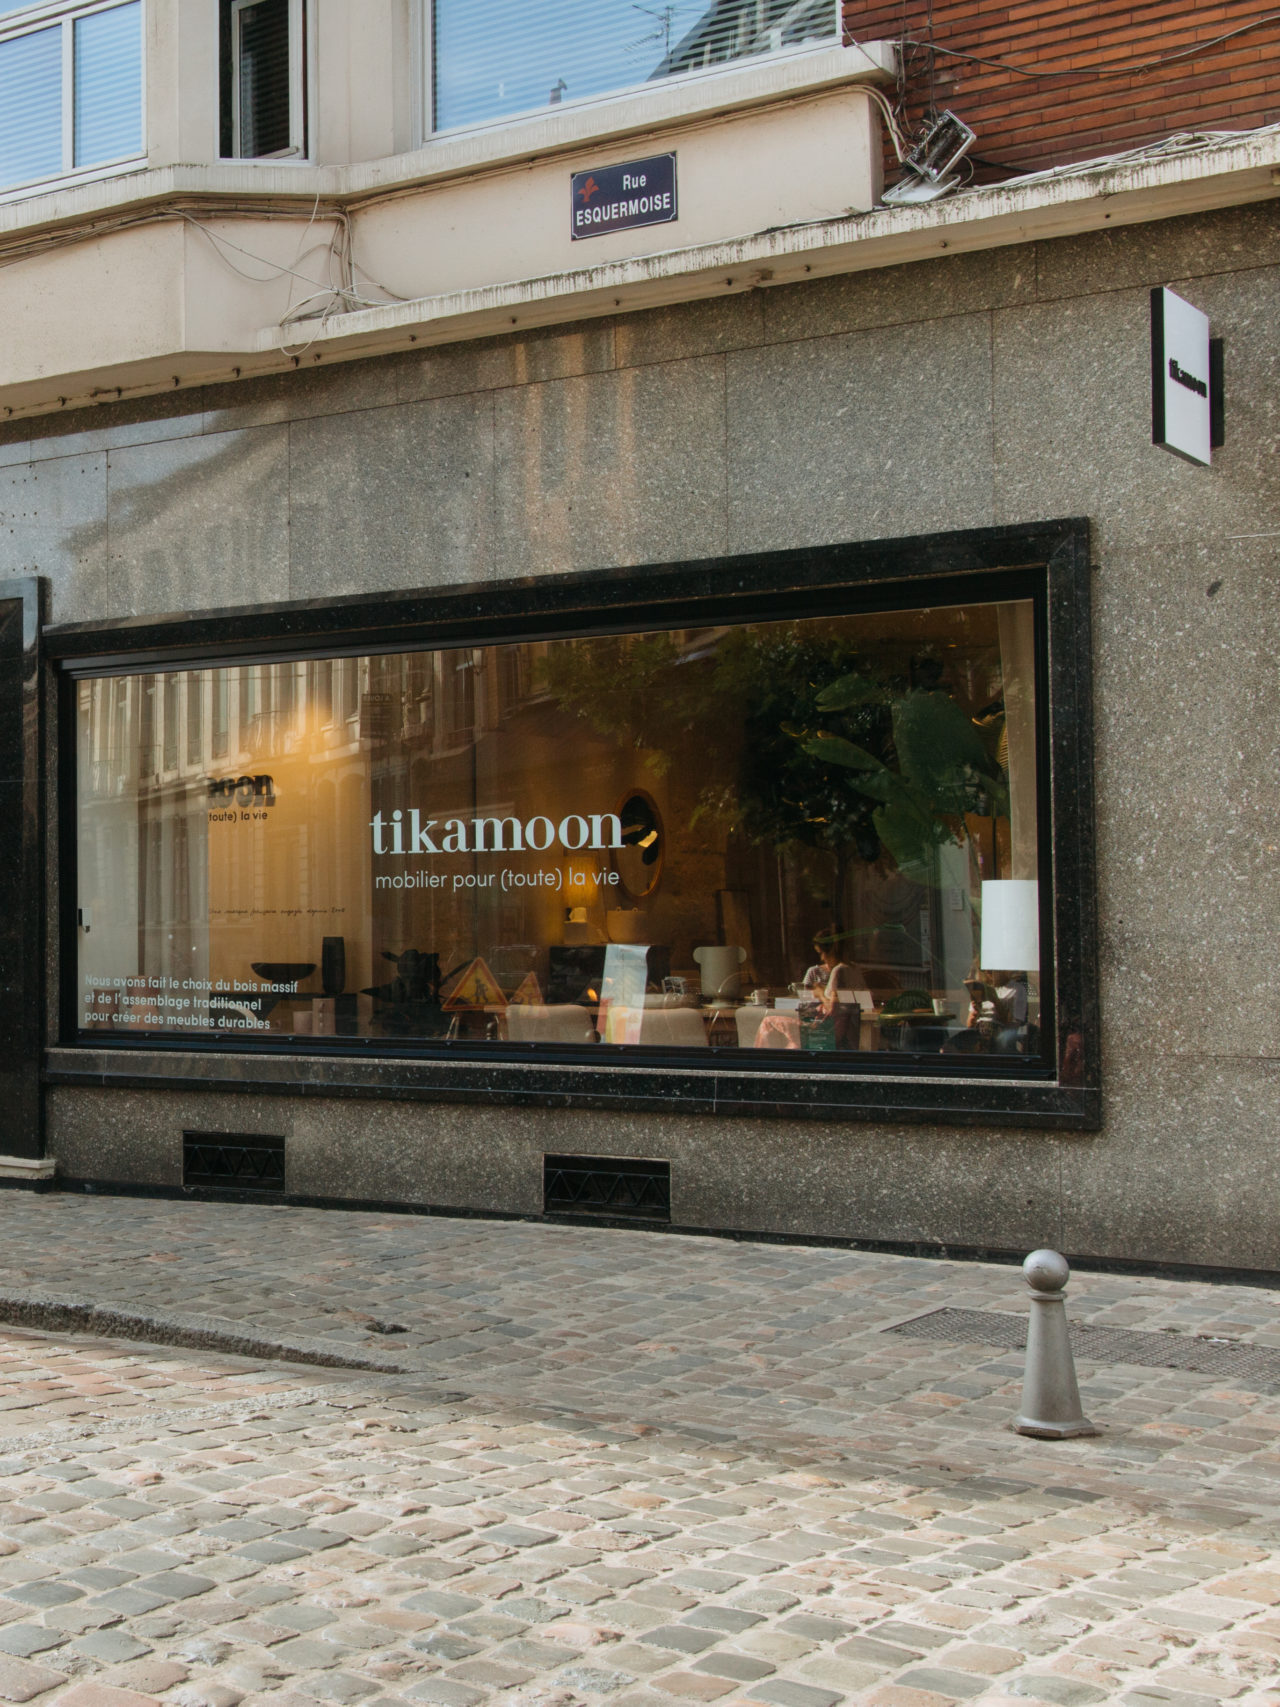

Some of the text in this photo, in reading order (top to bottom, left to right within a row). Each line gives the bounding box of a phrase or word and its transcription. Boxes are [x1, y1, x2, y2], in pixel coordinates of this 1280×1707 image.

[622, 174, 647, 191] Rue
[576, 192, 671, 227] ESQUERMOISE
[208, 810, 268, 824] toute) la vie
[369, 808, 626, 854] tikamoon
[375, 866, 620, 893] mobilier pour (toute) la vie
[84, 975, 299, 994] Nous avons fait le choix du bois massif
[84, 992, 95, 1003] et
[97, 993, 112, 1004] de
[193, 996, 263, 1011] traditionnel
[84, 1011, 271, 1030] pour créer des meubles durables
